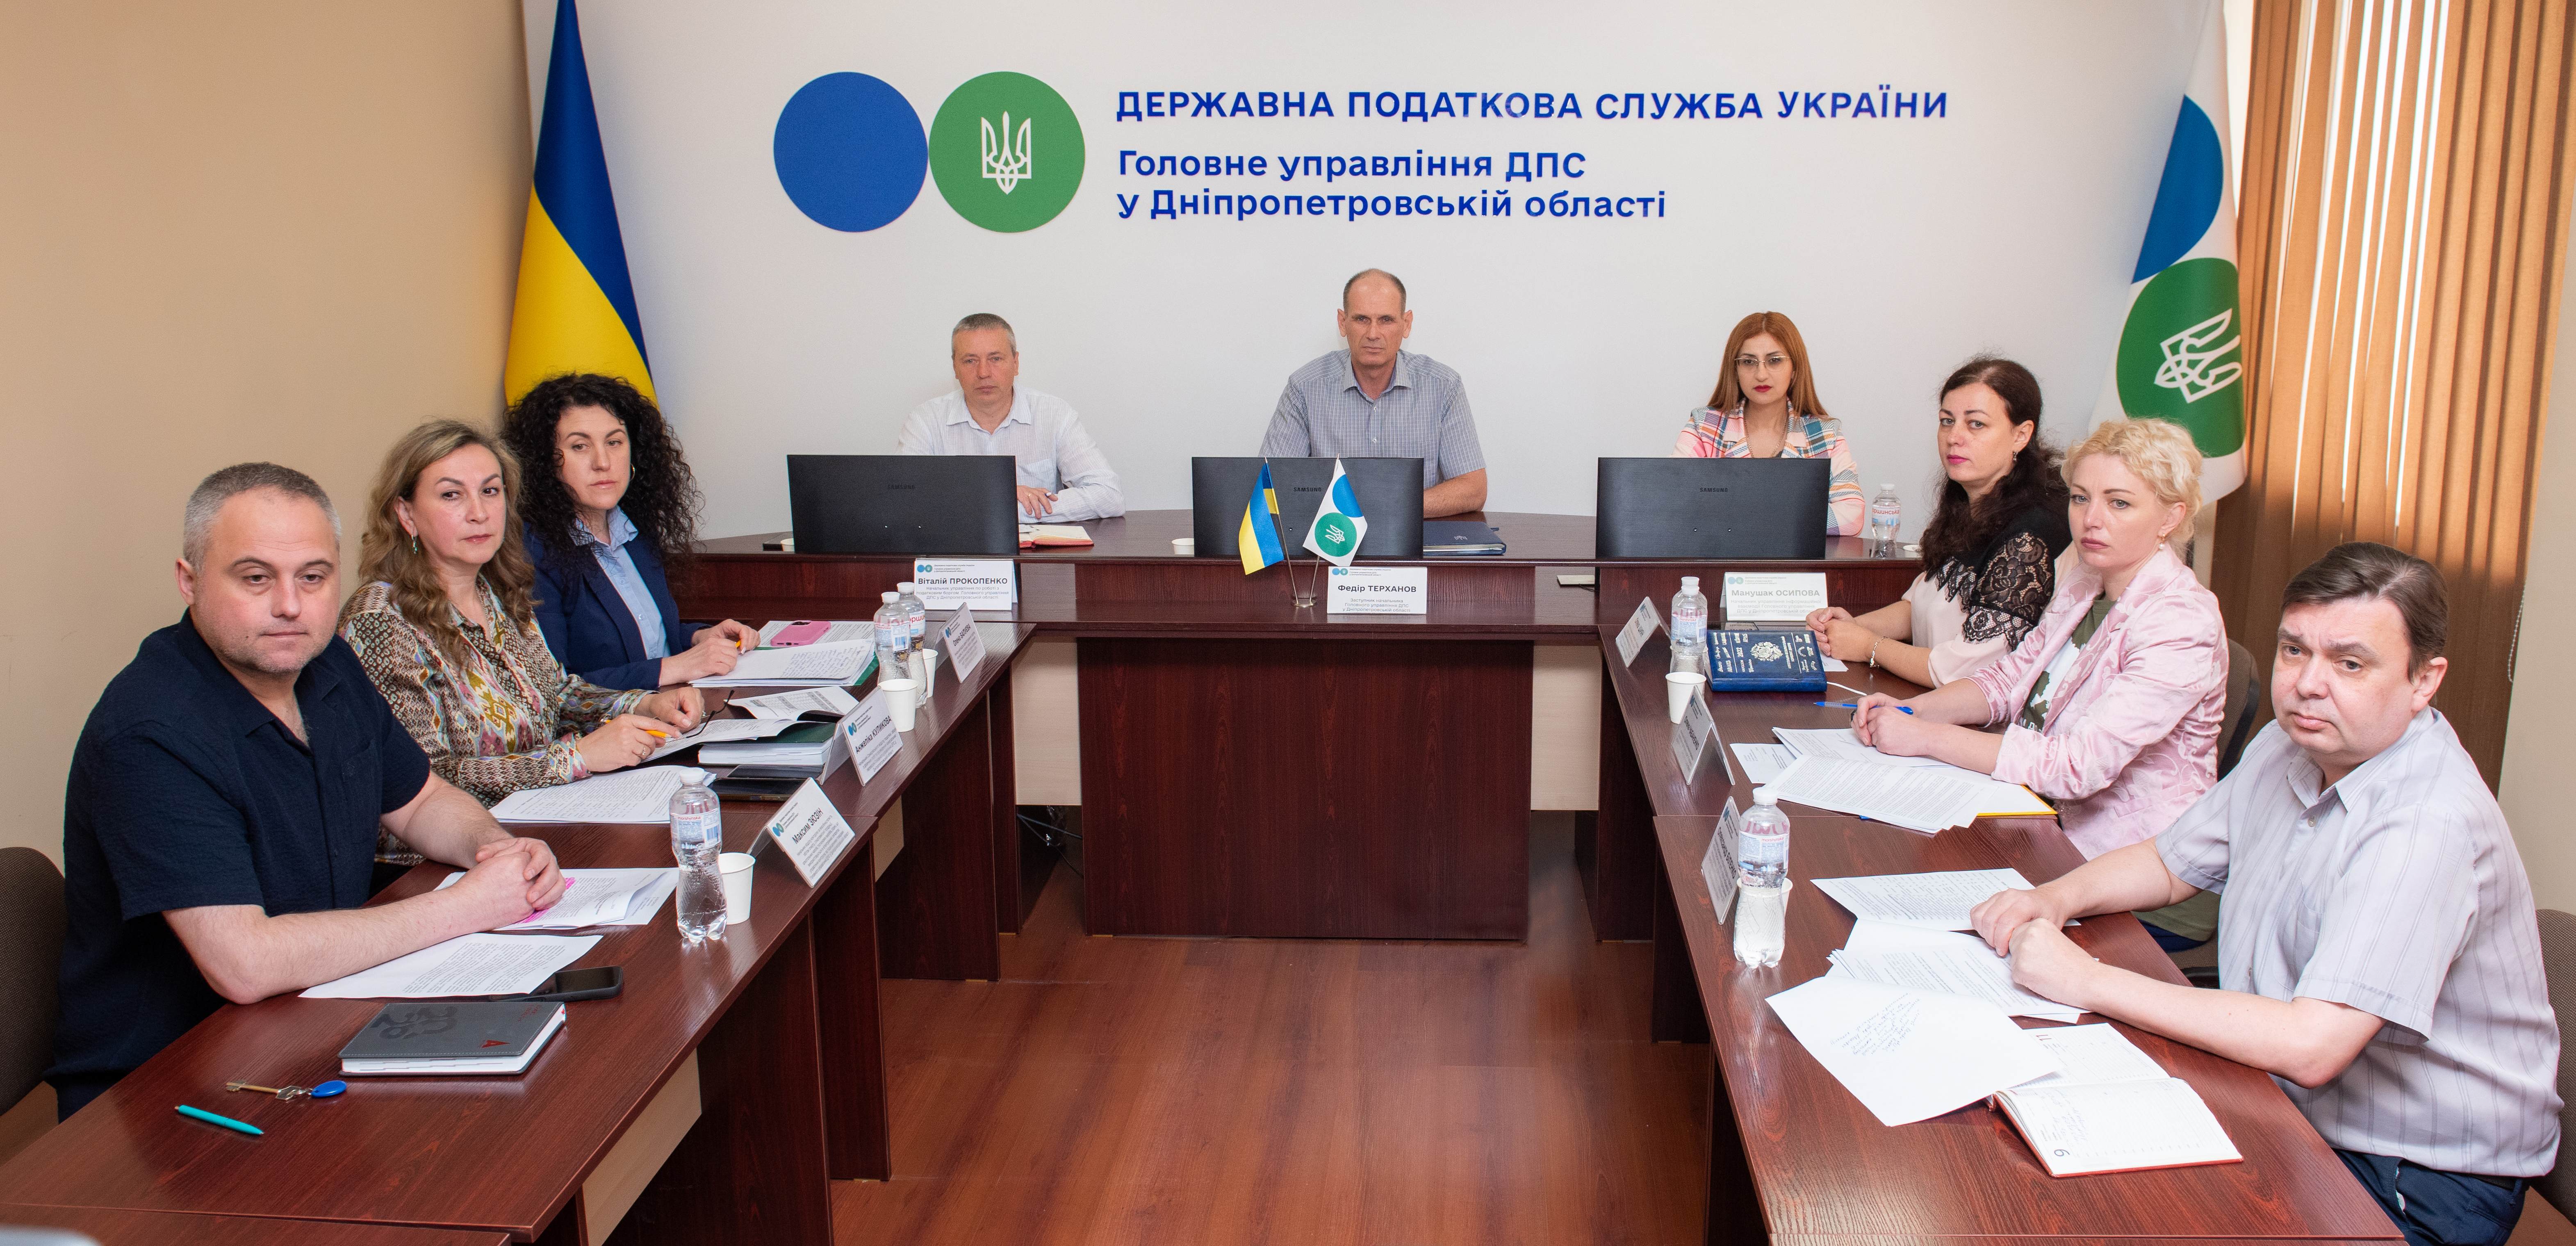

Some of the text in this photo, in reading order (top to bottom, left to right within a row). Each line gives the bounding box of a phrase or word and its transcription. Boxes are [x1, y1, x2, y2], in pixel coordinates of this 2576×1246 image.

[1116, 84, 1946, 121] ДЕРЖАВНА ПОДАТКОВА СЛУЖБА УКРАЇНИ
[1118, 149, 1585, 183] Головне управління ДПС
[1117, 188, 1665, 222] у Дніпропетровській області
[856, 735, 872, 753] Анжеліка
[872, 716, 891, 736] КУЛИКОВА
[793, 808, 823, 844] Максим ЗЮЗІН
[1718, 827, 1727, 857] Олександр
[1726, 852, 1736, 879] БІЛЕНКО
